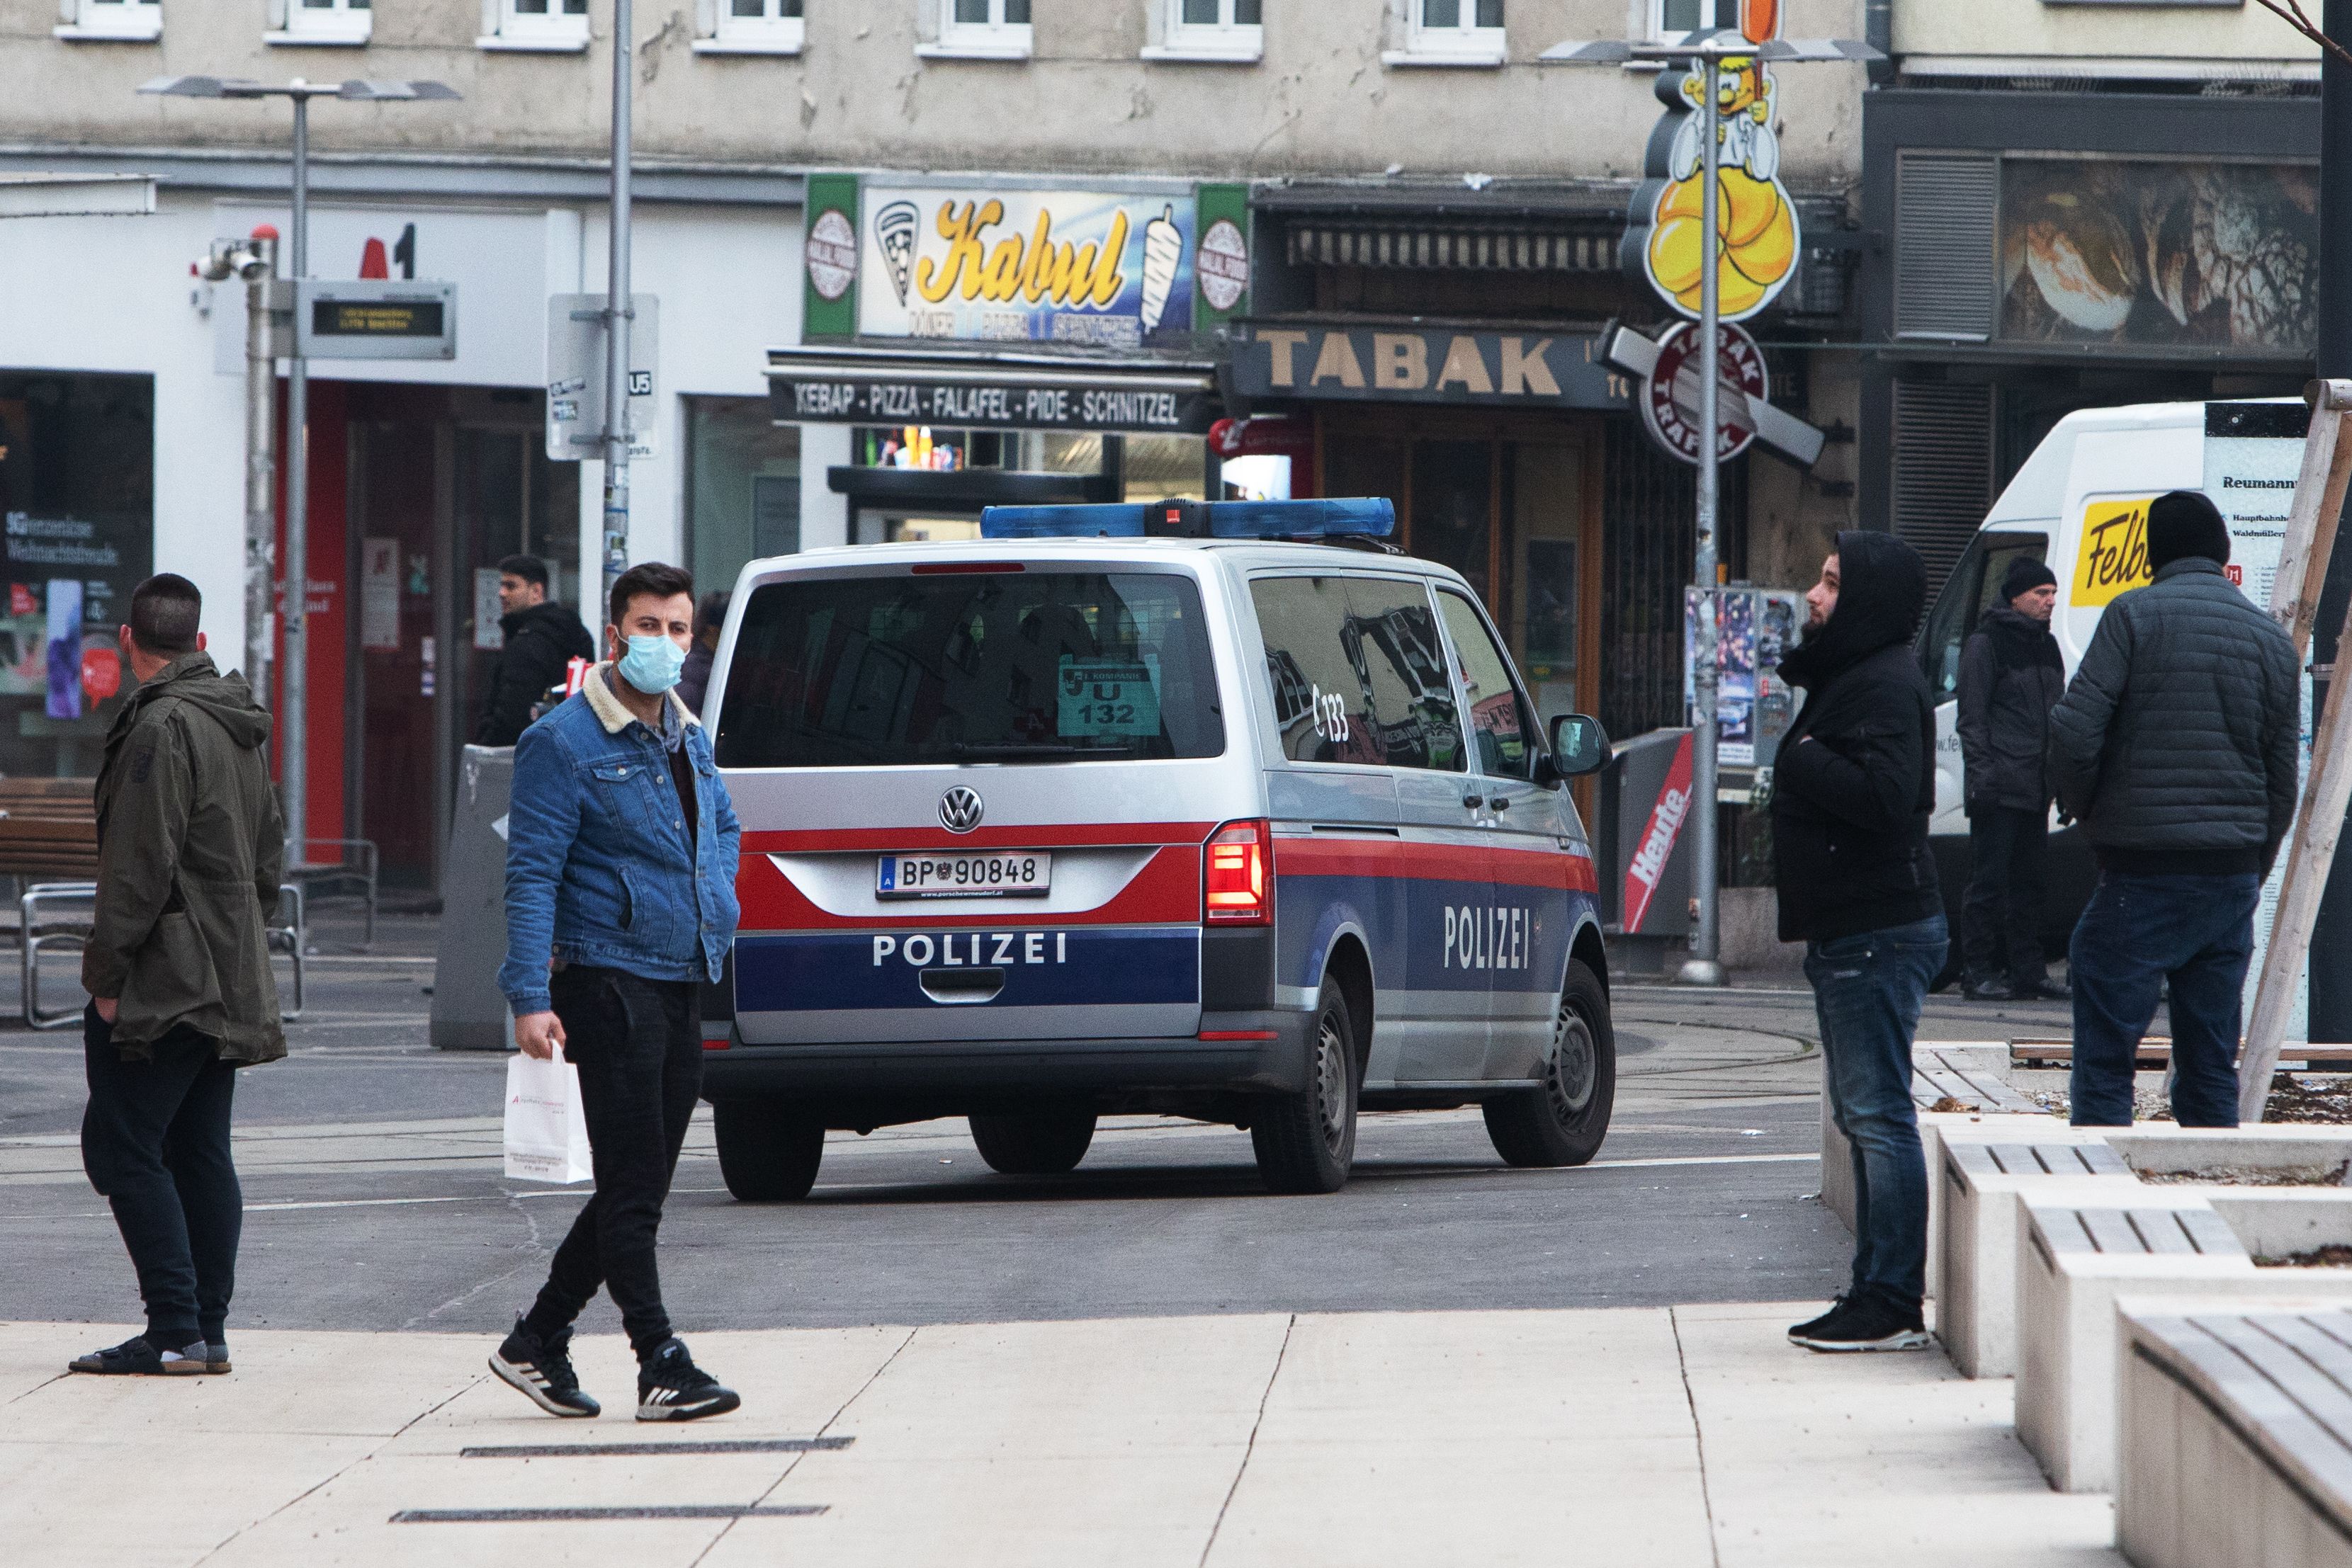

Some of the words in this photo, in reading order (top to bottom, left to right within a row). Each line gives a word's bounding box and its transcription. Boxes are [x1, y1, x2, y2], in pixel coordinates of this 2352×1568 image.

[917, 198, 1128, 306] Kabul
[1255, 329, 1561, 396] TABAK
[1672, 329, 1760, 382] TABAK
[794, 383, 854, 414] KEBAP
[870, 385, 920, 416] PIZZA
[933, 386, 1012, 419] FALAFEL
[1026, 390, 1068, 421] PIDE
[1083, 390, 1180, 425] SCHNITZEL
[1655, 379, 1735, 452] TRAFK
[2222, 476, 2297, 489] Reumann
[1078, 704, 1135, 724] 132
[1093, 684, 1121, 701] U
[1321, 693, 1349, 742] 133
[939, 786, 983, 831] VW
[1629, 788, 1687, 886] Heute
[903, 860, 934, 885] BP
[955, 858, 1036, 885] 90848
[873, 932, 1066, 967] POLIZEI
[1444, 906, 1529, 969] POLIZEI
